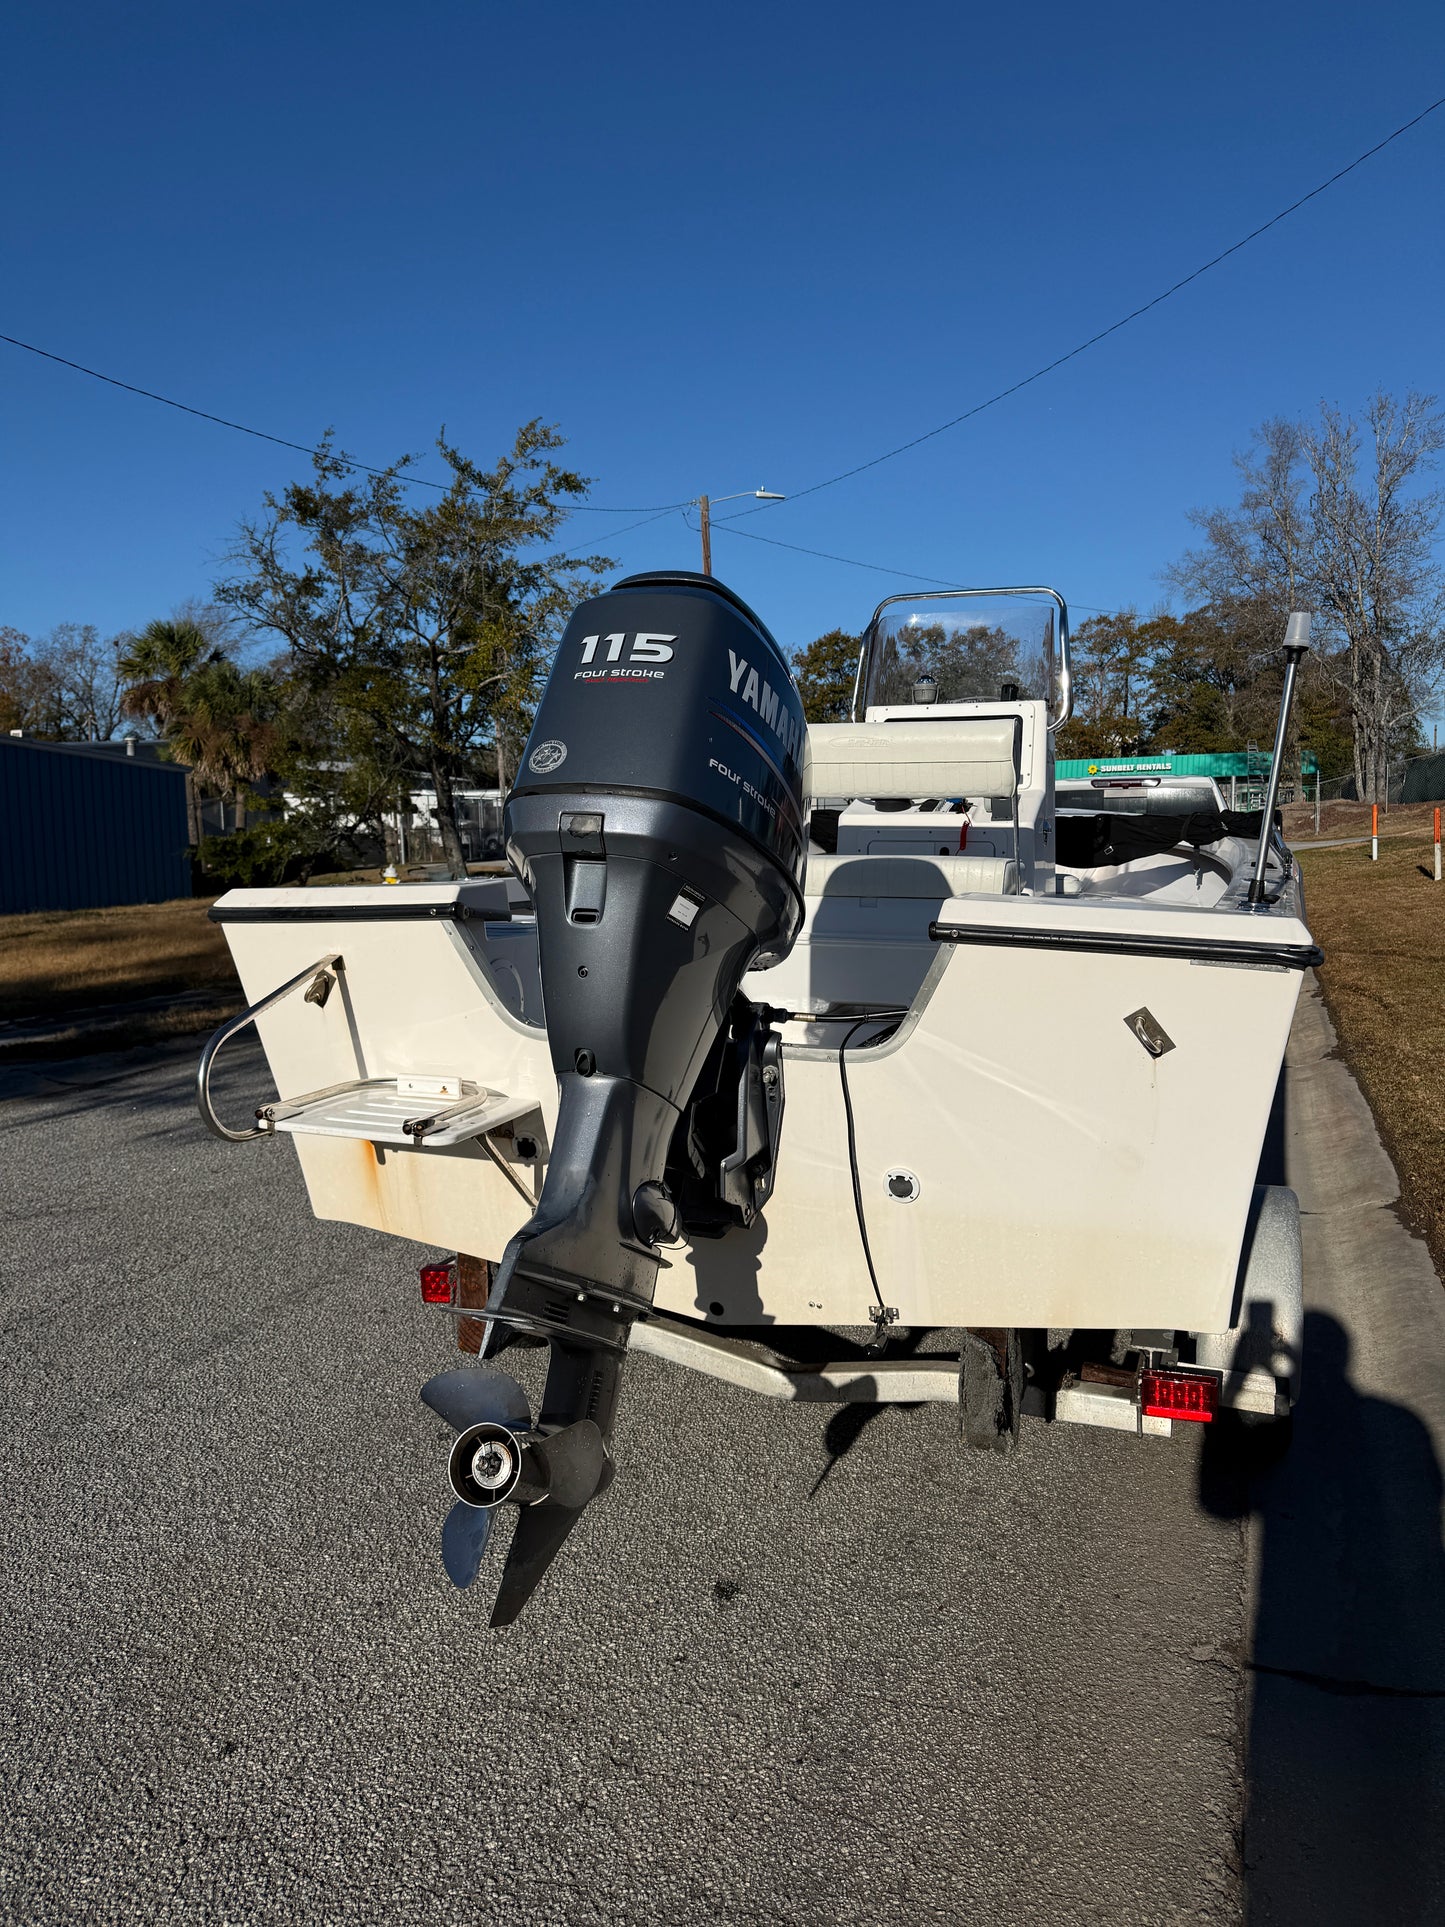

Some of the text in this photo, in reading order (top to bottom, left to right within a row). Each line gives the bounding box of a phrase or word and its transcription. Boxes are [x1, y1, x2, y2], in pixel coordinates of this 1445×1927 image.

[580, 632, 679, 664] 115
[1100, 762, 1172, 773] SUNBELT RENTALS
